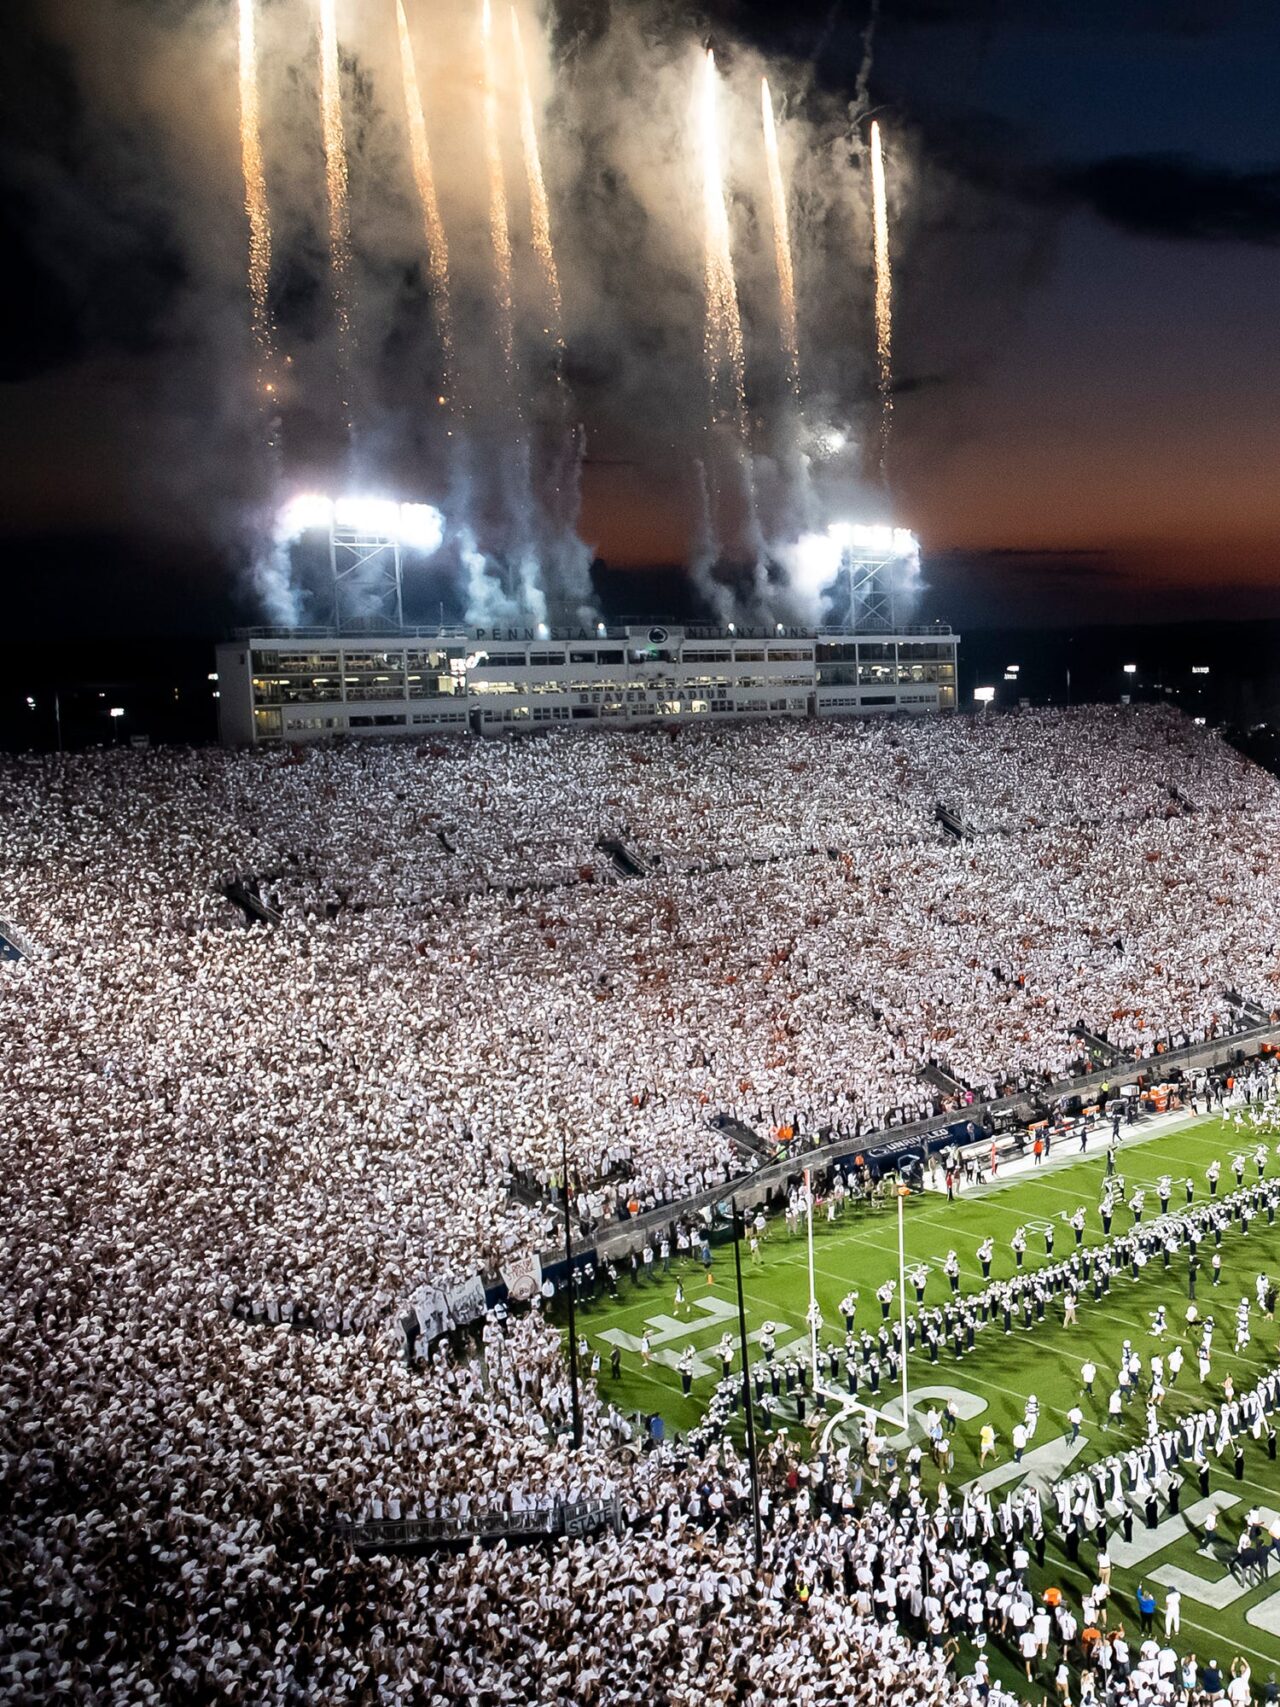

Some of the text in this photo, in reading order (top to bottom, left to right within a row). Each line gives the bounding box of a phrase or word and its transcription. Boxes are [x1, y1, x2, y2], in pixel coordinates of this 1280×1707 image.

[476, 627, 535, 640] PENN
[688, 627, 755, 638] NITTANY
[763, 627, 809, 638] LIONS
[580, 689, 728, 704] BEAVER STADIUM
[569, 1507, 613, 1535] STATE
